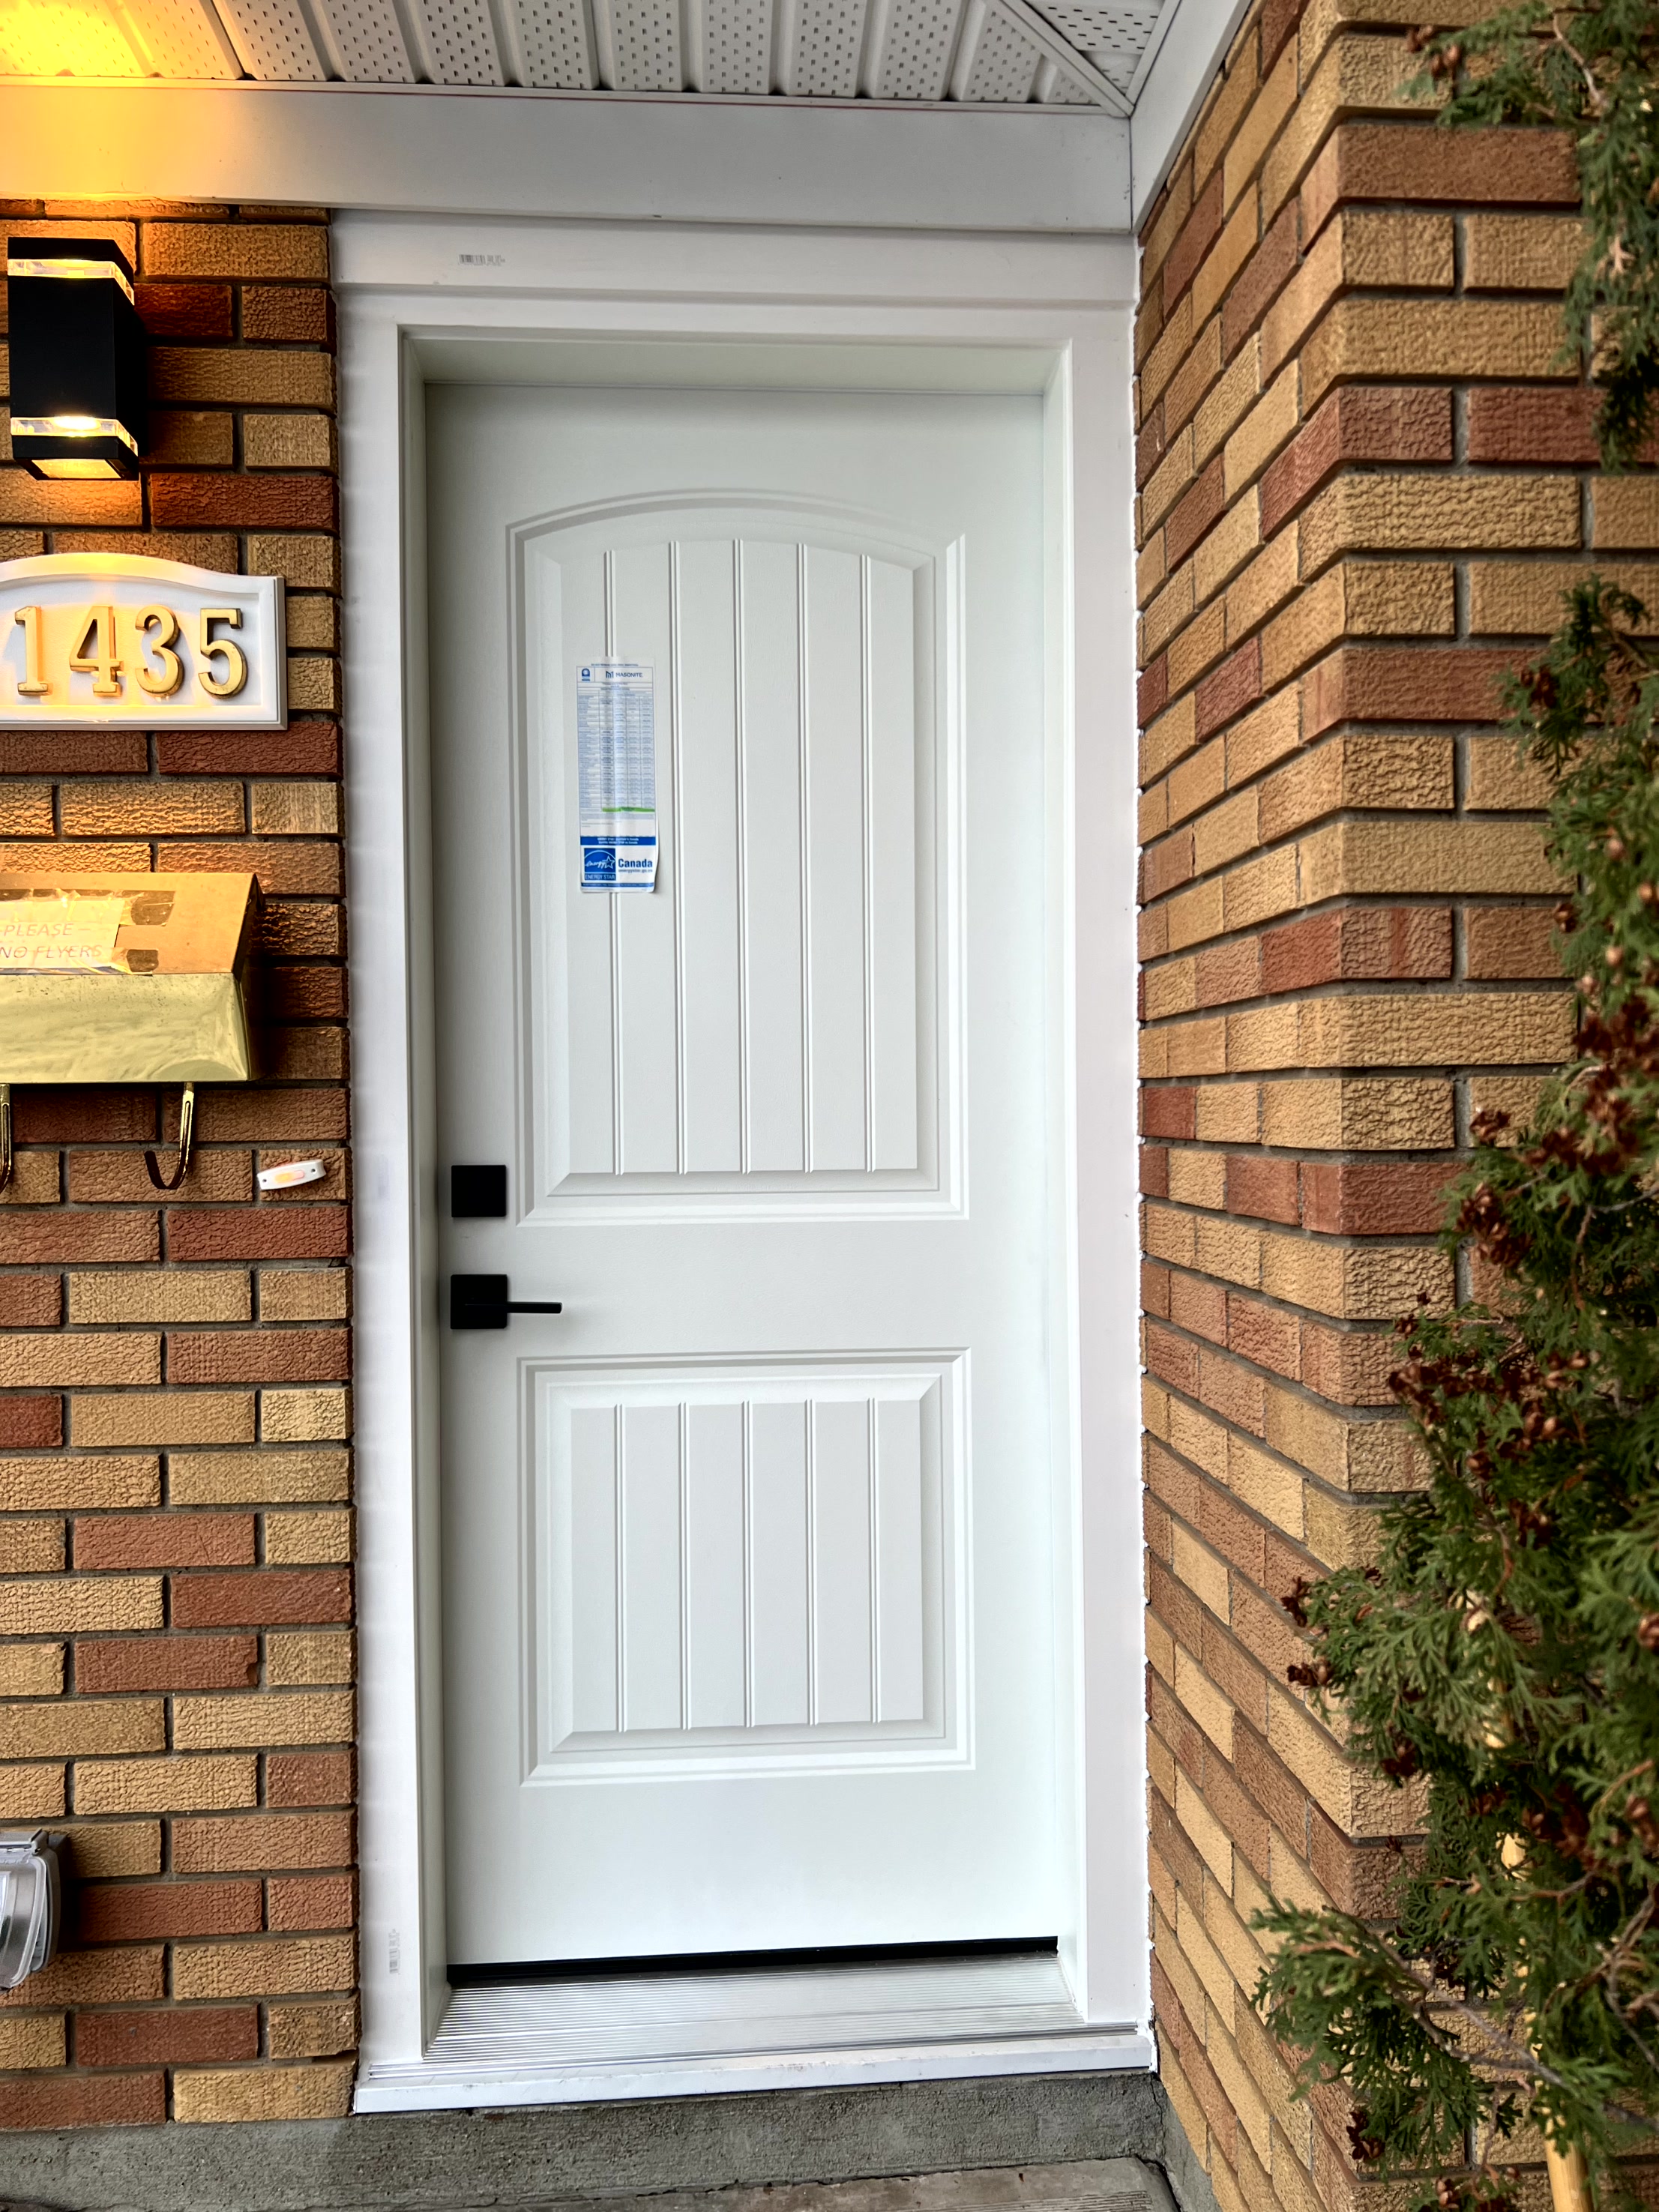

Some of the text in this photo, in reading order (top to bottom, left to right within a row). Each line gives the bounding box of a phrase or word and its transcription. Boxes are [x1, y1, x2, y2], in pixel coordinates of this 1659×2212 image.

[14, 604, 248, 699] 1435
[618, 858, 653, 868] Canada
[4, 923, 74, 937] PLEASE
[0, 944, 103, 959] NO FLYERS
